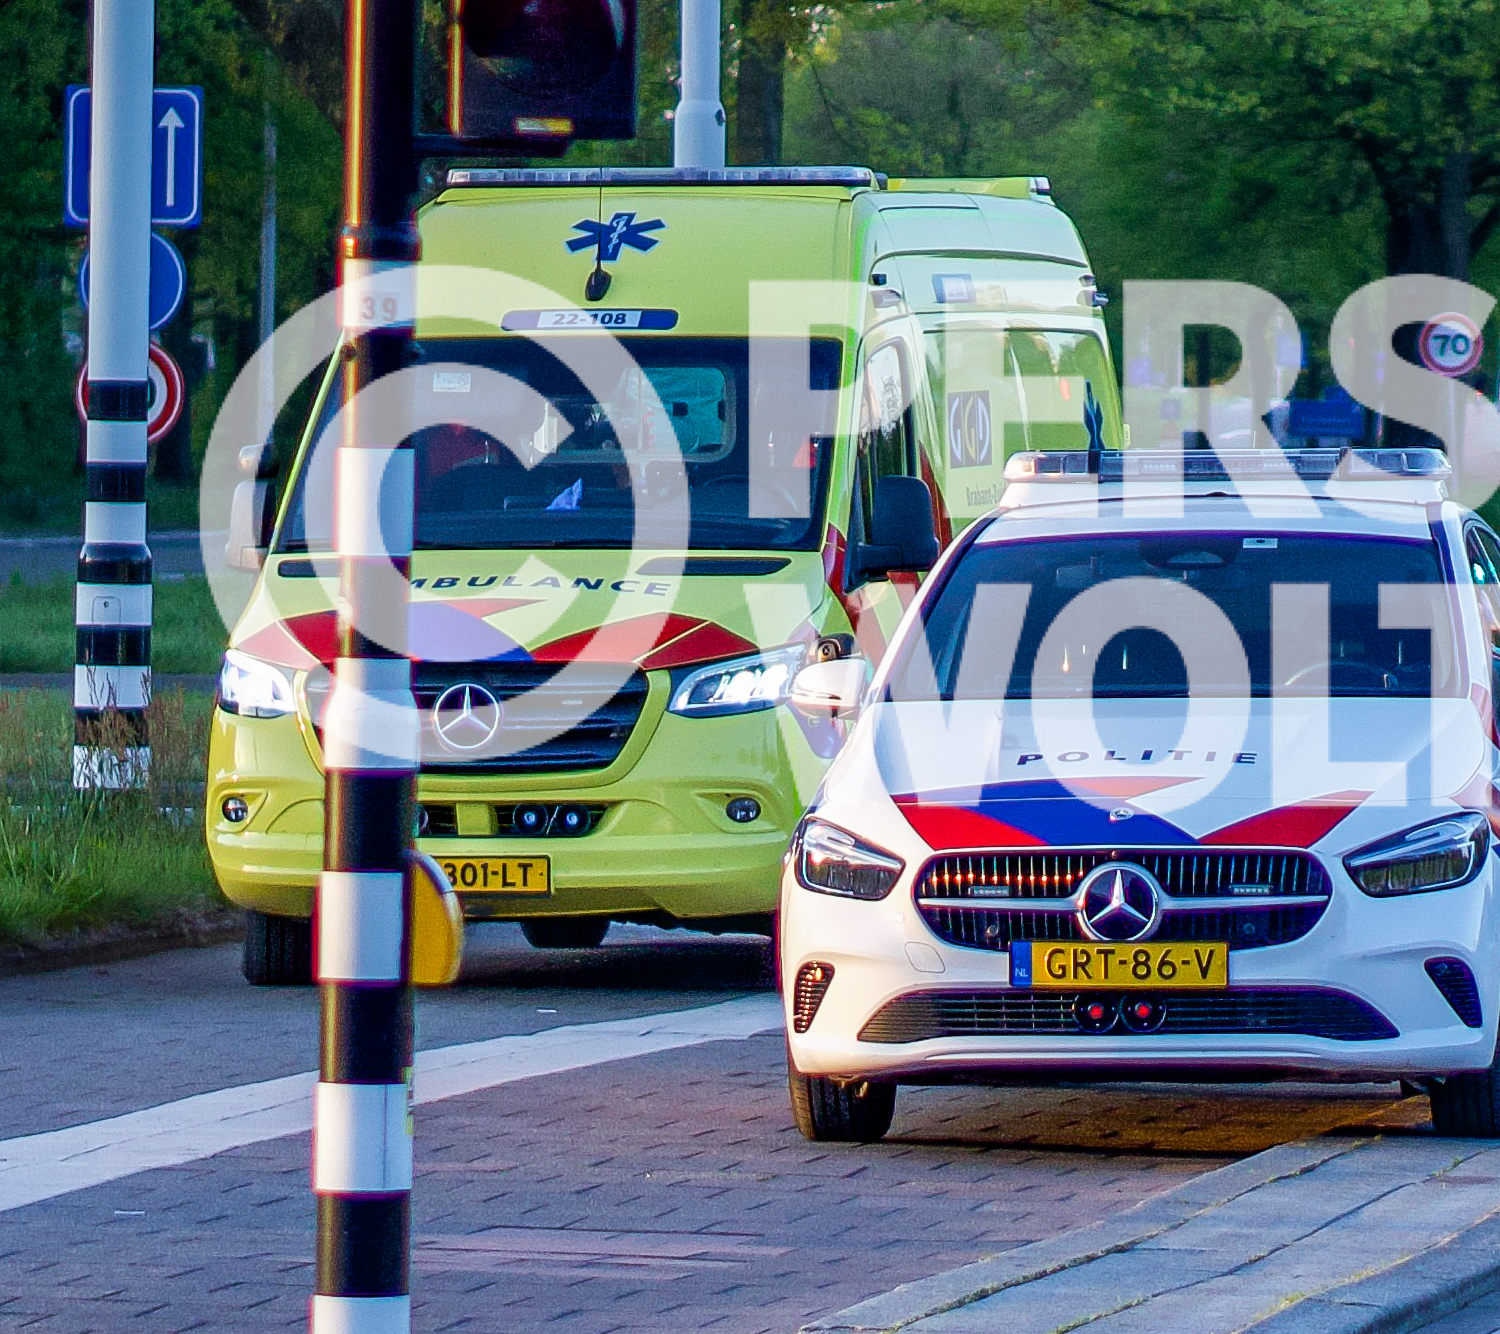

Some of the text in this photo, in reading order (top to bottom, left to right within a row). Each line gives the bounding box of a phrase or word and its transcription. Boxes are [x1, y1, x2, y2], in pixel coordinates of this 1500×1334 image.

[552, 312, 627, 326] 22-108
[1432, 334, 1469, 356] 70
[1016, 749, 1258, 766] POLITIE
[443, 862, 534, 888] 301-LT
[1014, 948, 1215, 979] NL GRT-86-V
